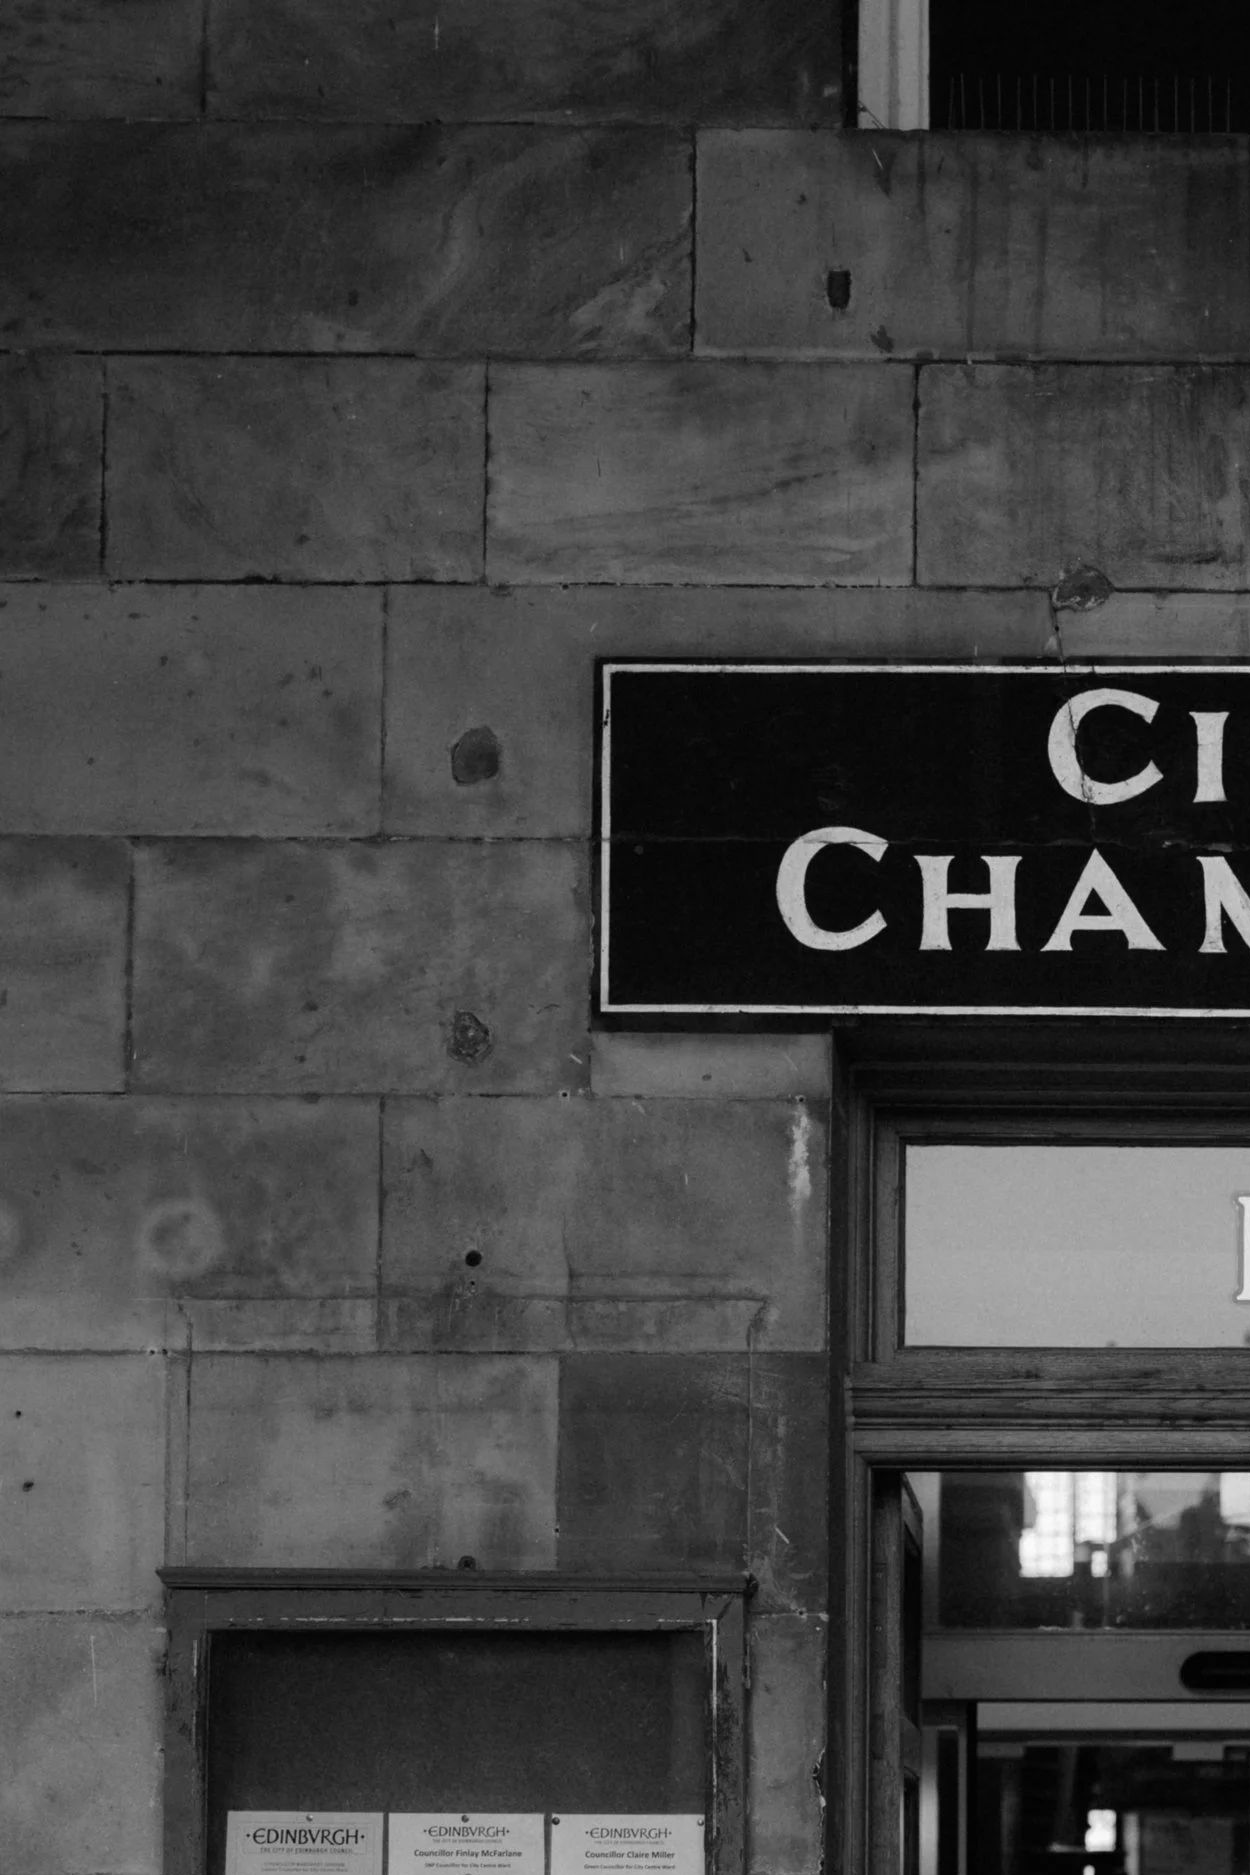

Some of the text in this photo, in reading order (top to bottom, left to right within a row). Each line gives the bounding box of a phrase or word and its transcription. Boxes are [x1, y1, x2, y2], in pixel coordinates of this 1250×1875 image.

[413, 1849, 523, 1859] Councillor Finlay McFarlane
[584, 1850, 676, 1859] Councillor Claire Miller
